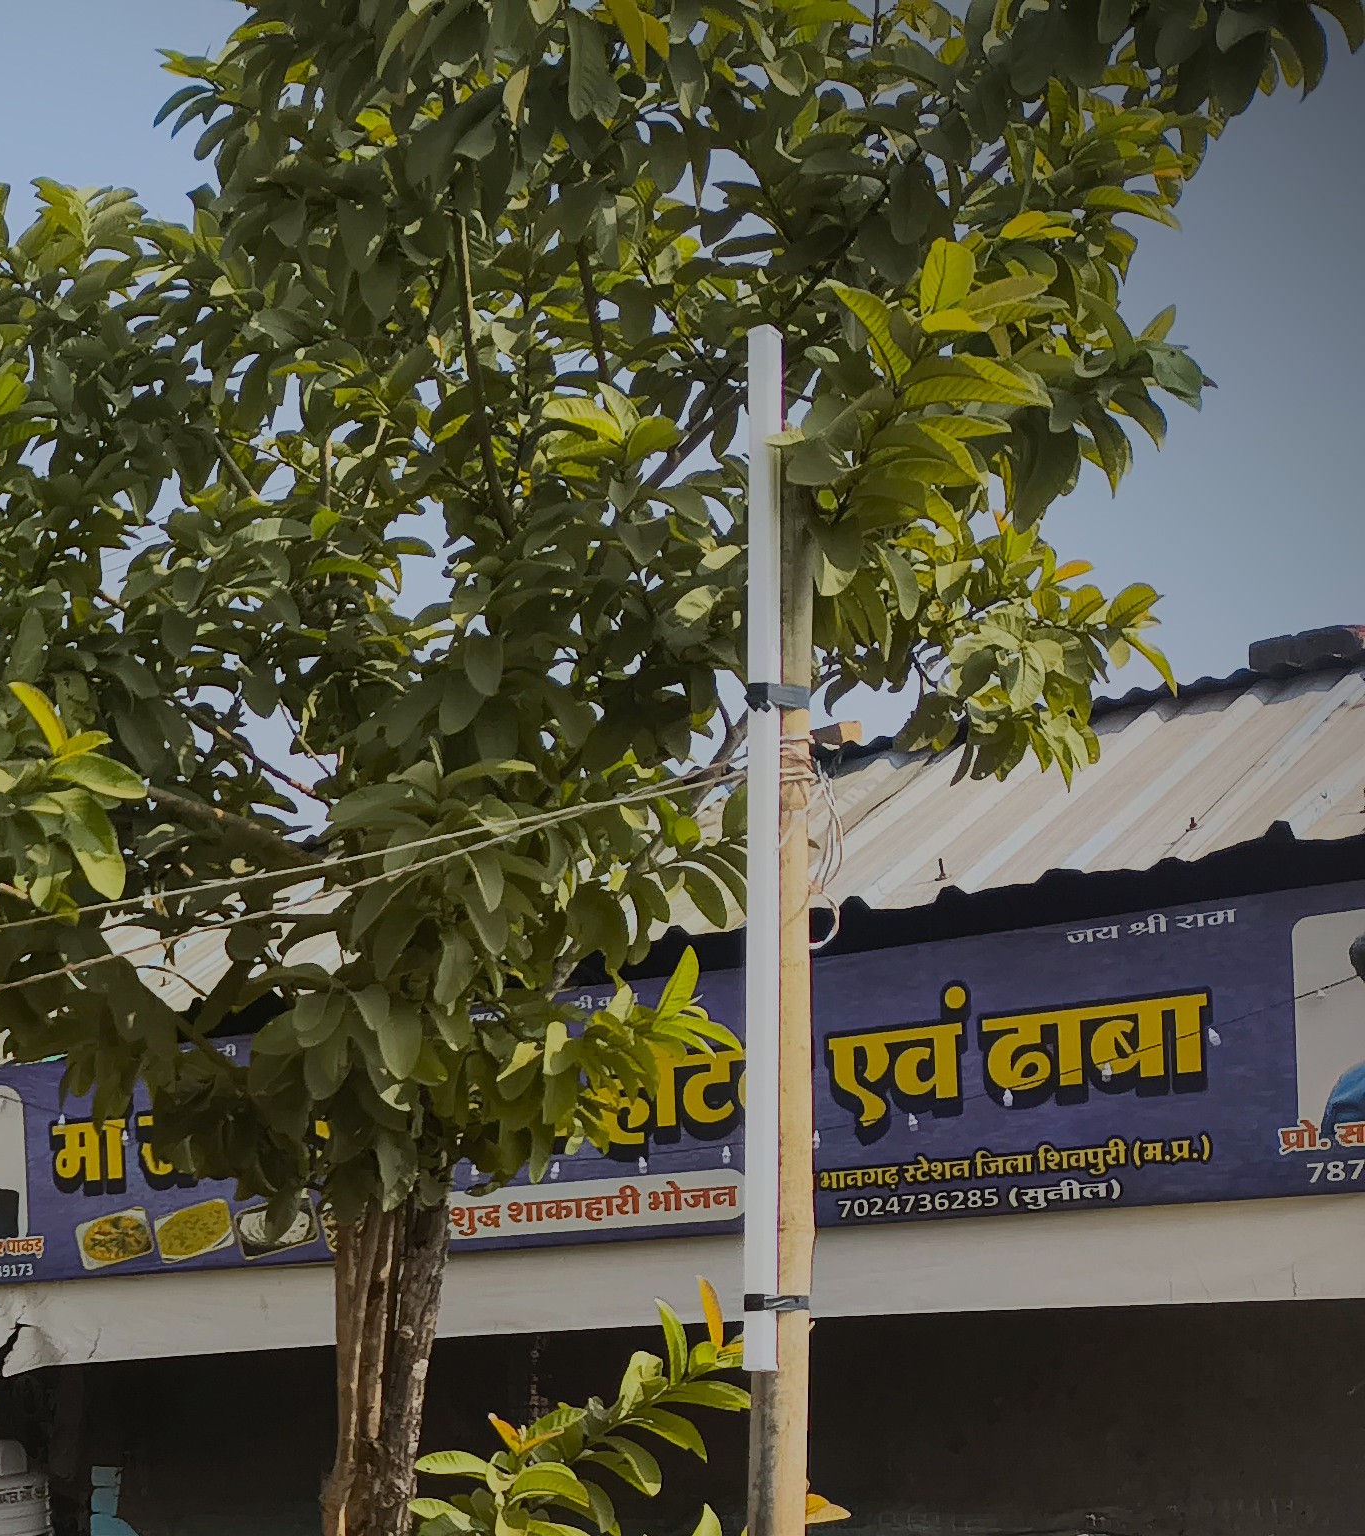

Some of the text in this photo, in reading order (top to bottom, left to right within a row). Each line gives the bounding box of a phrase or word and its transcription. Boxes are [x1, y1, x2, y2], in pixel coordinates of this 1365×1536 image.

[1066, 908, 1237, 943] जय श्री राम
[828, 986, 965, 1127] एवं
[981, 993, 1209, 1092] ढाबा
[820, 1166, 899, 1189] भानगढ़
[903, 1156, 970, 1183] स्टेशन
[975, 1151, 1033, 1177] जिला
[1038, 1139, 1127, 1174] शिवपुरी
[449, 1180, 738, 1236] शुद्ध शाकाहारी भोजन
[838, 1178, 1123, 1218] 7024736285 (सुनील)
